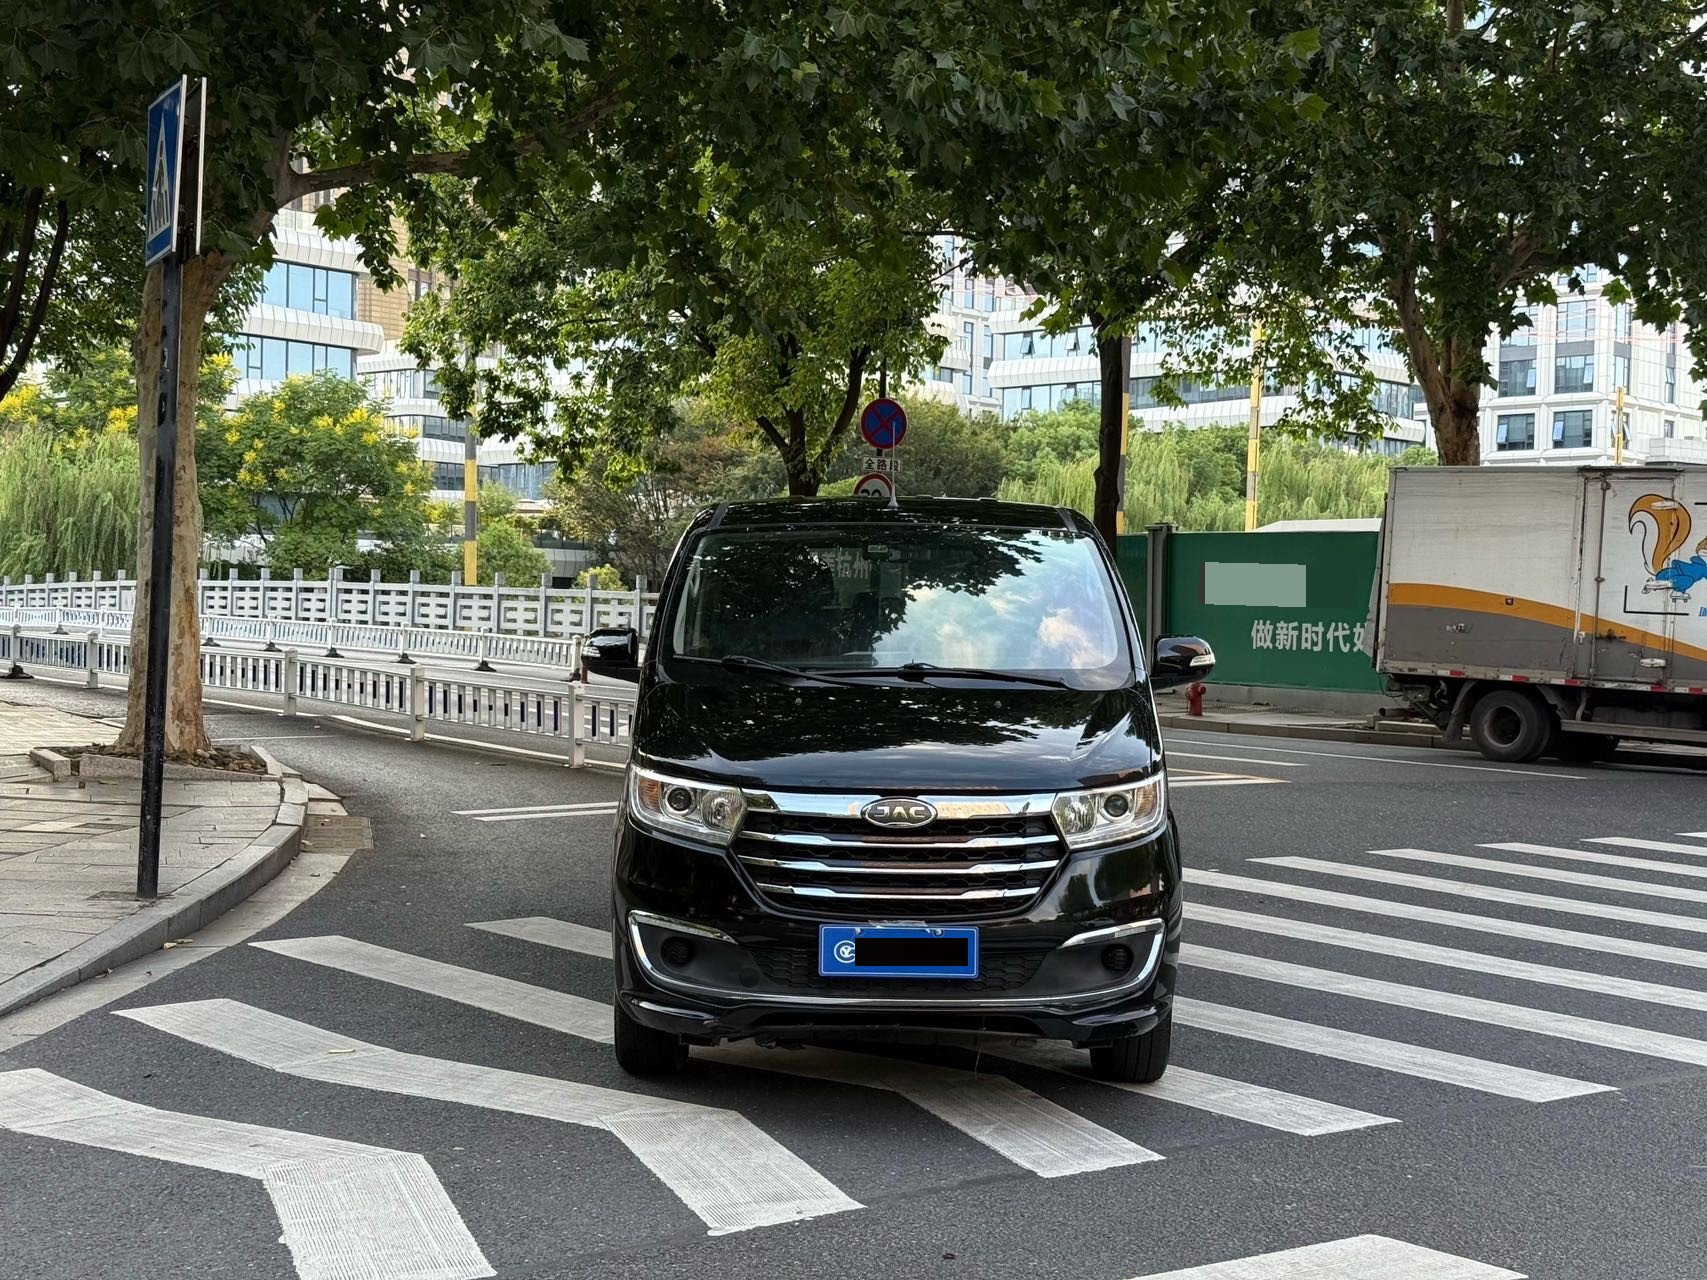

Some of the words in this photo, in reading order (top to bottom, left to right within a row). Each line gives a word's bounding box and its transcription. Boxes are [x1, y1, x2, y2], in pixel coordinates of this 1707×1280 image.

[864, 458, 899, 472] 全路段
[874, 806, 926, 819] JAC
